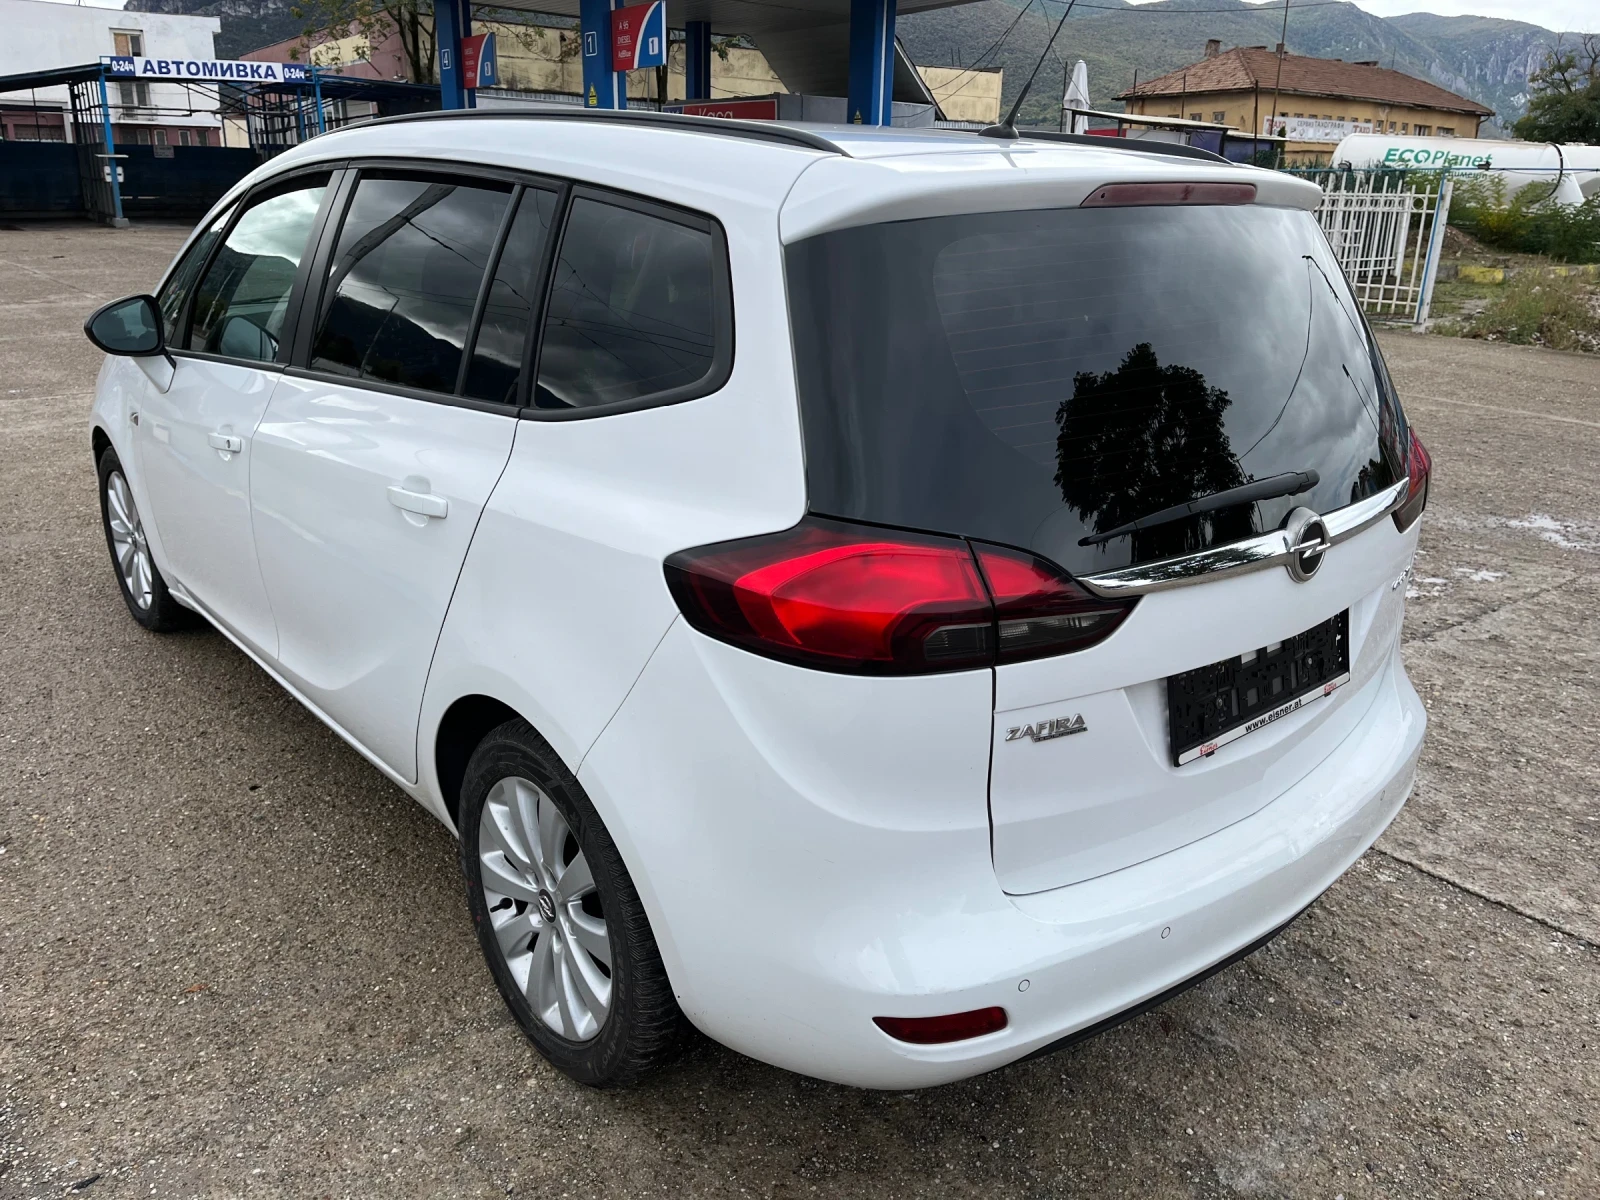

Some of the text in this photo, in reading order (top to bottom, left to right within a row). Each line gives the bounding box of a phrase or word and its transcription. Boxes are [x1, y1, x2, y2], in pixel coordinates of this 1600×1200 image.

[618, 35, 631, 44] DIESEL
[443, 51, 449, 66] 4
[142, 59, 277, 79] АВТОМИВКА
[1245, 698, 1302, 733] www.eisner.at
[1005, 713, 1086, 741] ZAFIRA
